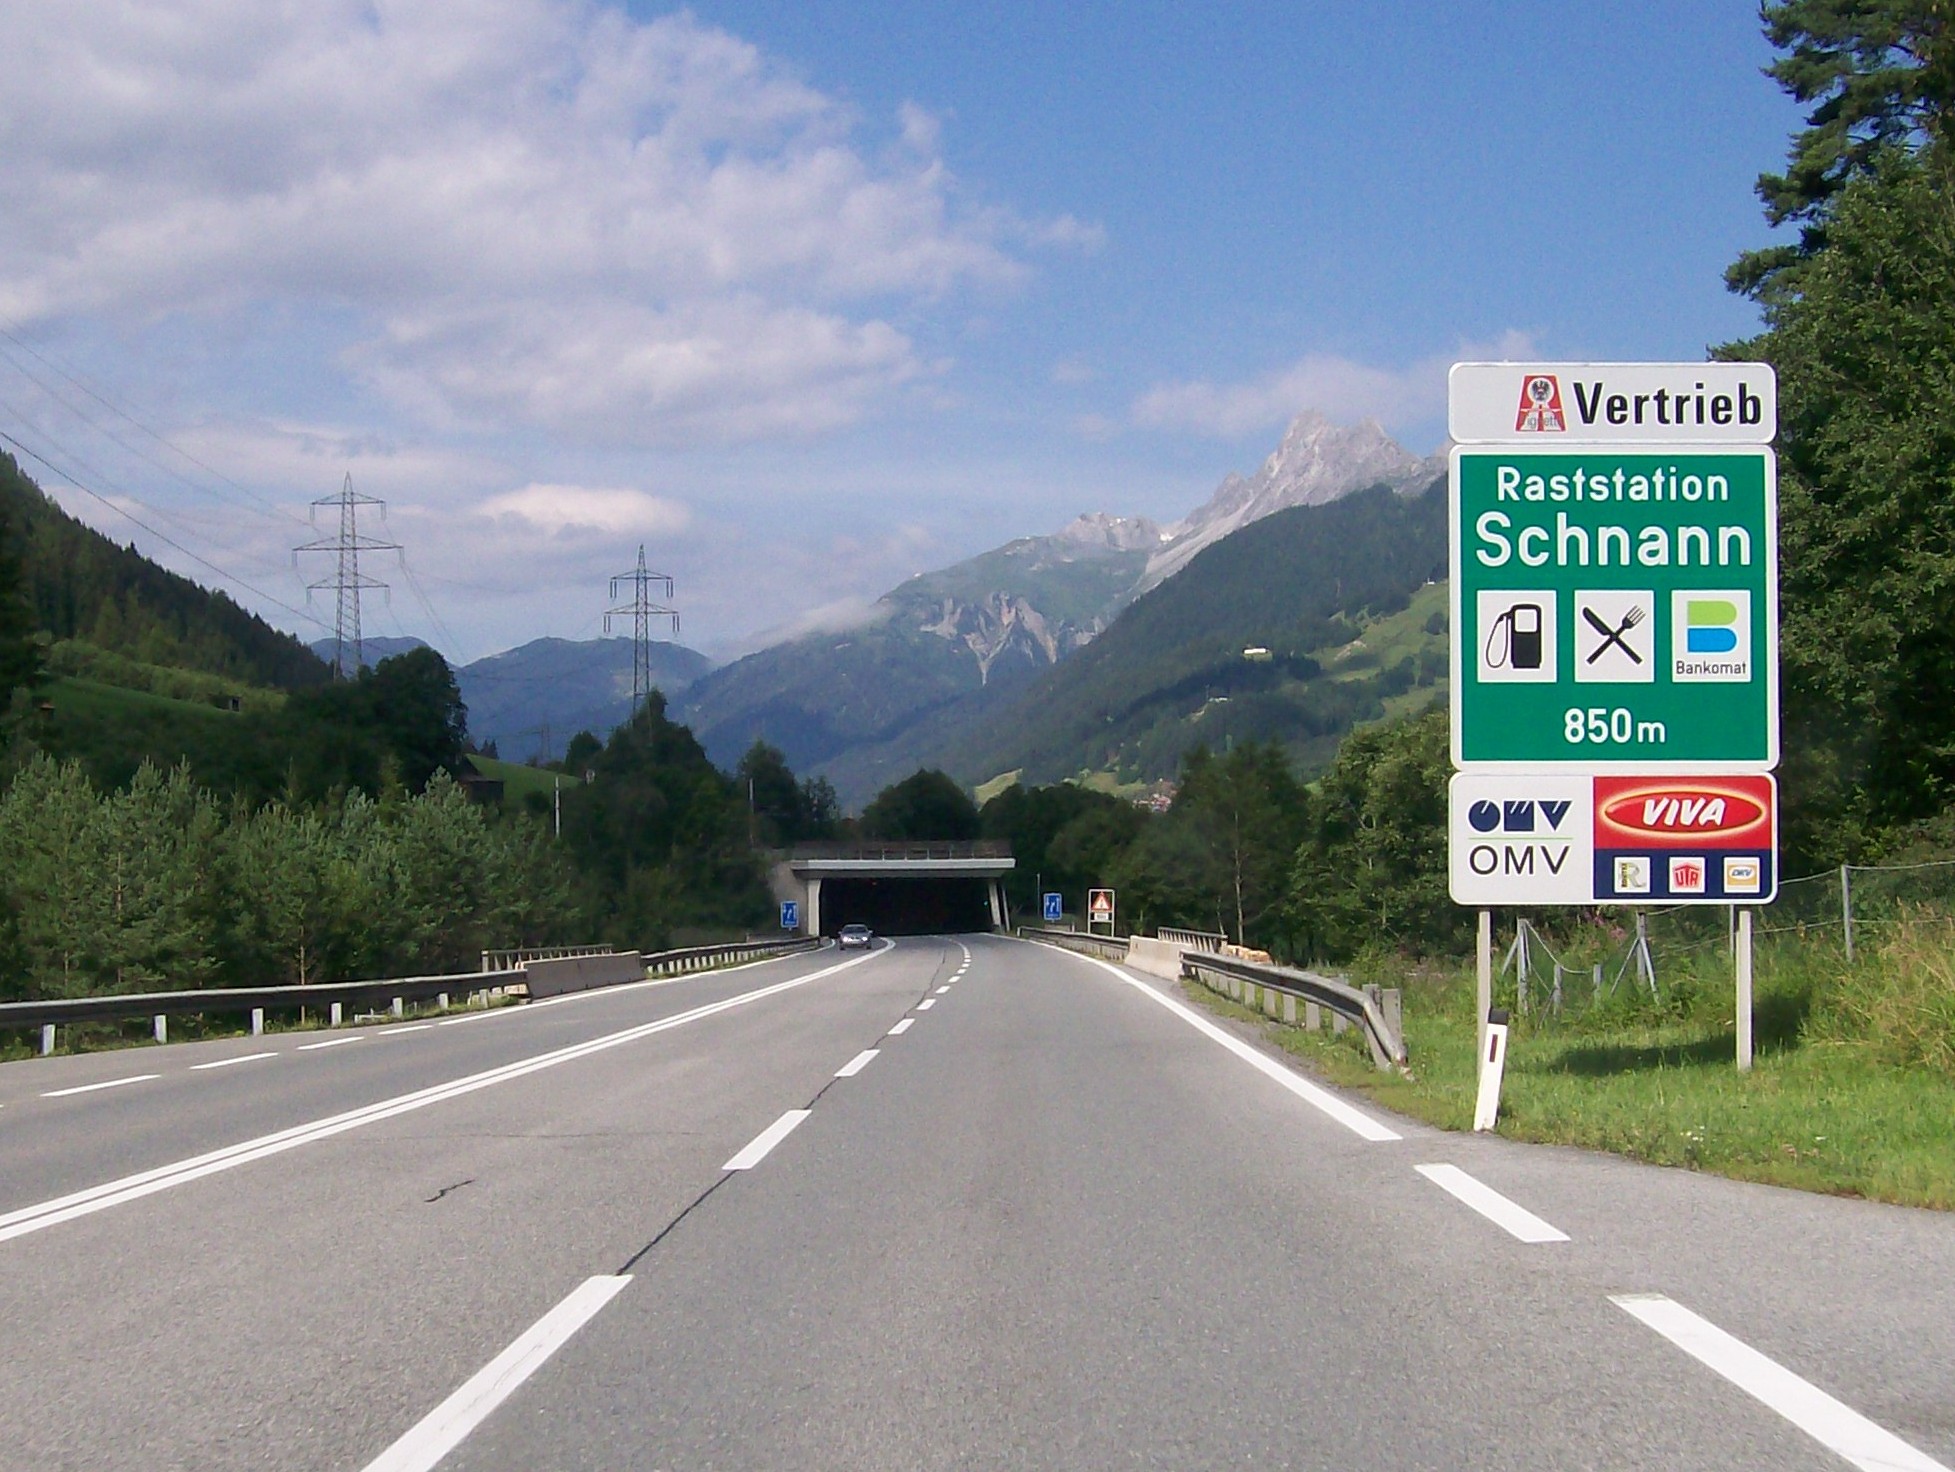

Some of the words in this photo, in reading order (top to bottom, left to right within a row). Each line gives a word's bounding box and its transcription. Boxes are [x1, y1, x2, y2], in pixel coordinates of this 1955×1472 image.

[1573, 382, 1762, 425] Vertrieb
[1497, 466, 1729, 501] Raststation
[1476, 511, 1751, 567] Schnann
[1676, 660, 1747, 675] Bankomat
[1642, 797, 1727, 826] VIVA
[1469, 844, 1571, 875] OMV
[1674, 863, 1700, 887] UTA
